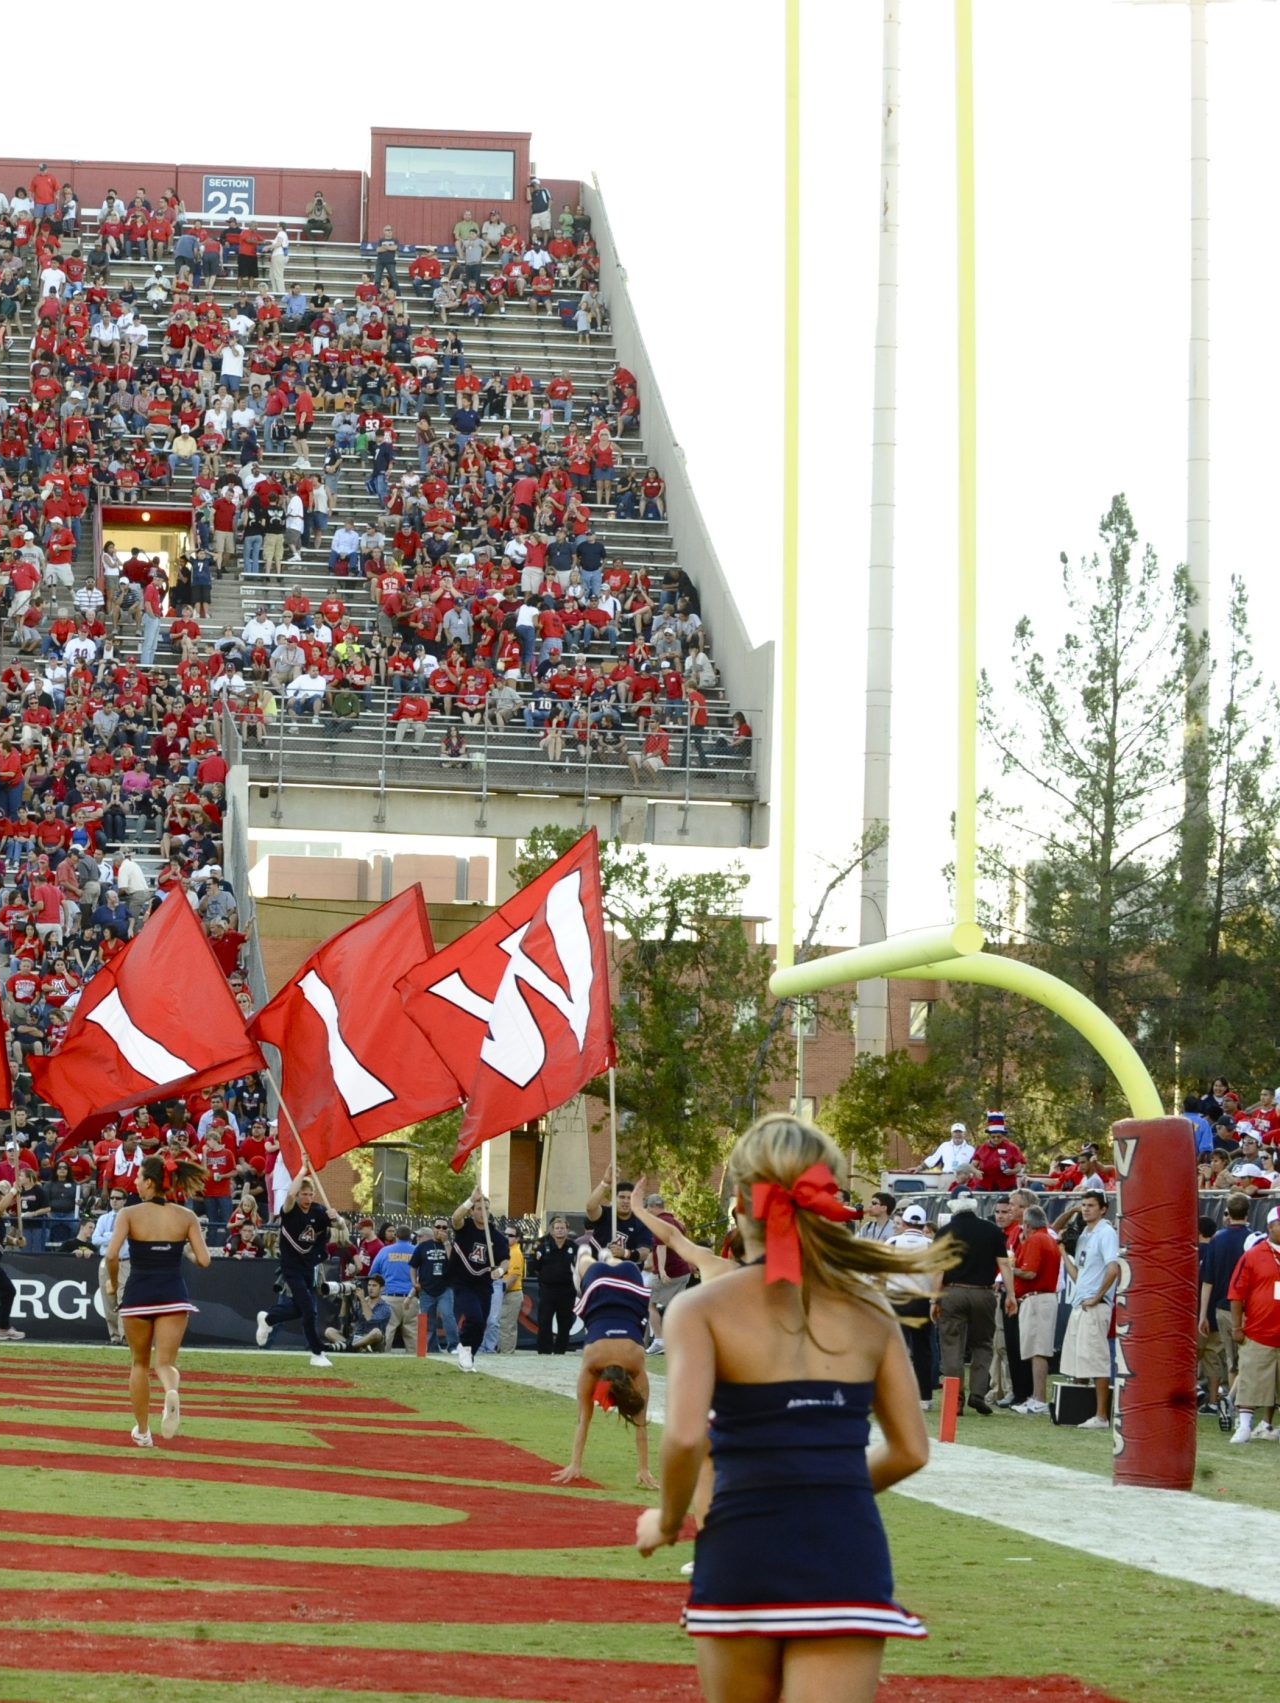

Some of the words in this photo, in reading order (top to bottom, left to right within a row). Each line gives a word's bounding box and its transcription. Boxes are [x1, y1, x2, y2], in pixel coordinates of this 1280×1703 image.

[208, 178, 249, 188] SECTION
[207, 191, 250, 216] 25
[365, 420, 380, 432] 93
[197, 562, 204, 572] 7
[469, 1243, 487, 1264] A
